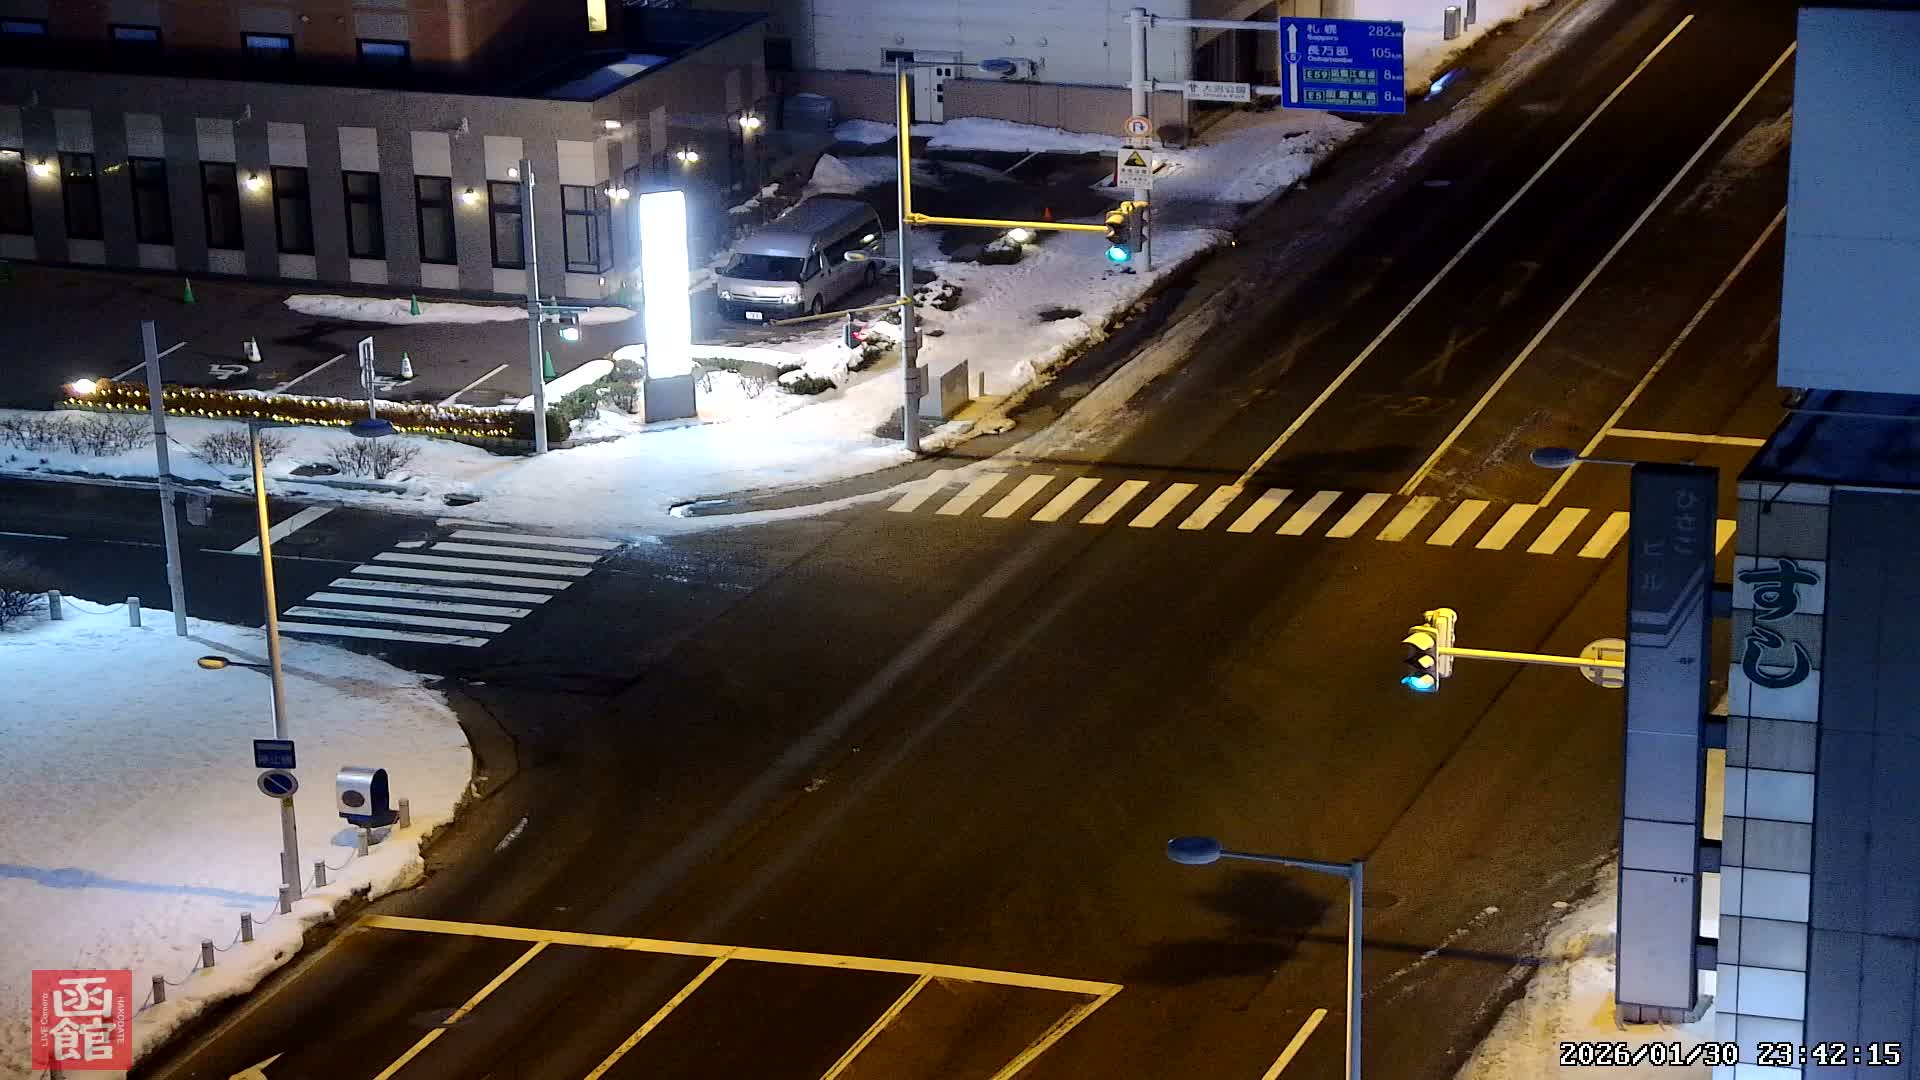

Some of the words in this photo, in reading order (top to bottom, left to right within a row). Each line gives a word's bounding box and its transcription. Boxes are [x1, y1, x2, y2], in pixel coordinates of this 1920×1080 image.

[1307, 24, 1337, 34] 札幌
[1308, 45, 1348, 56] 長万部
